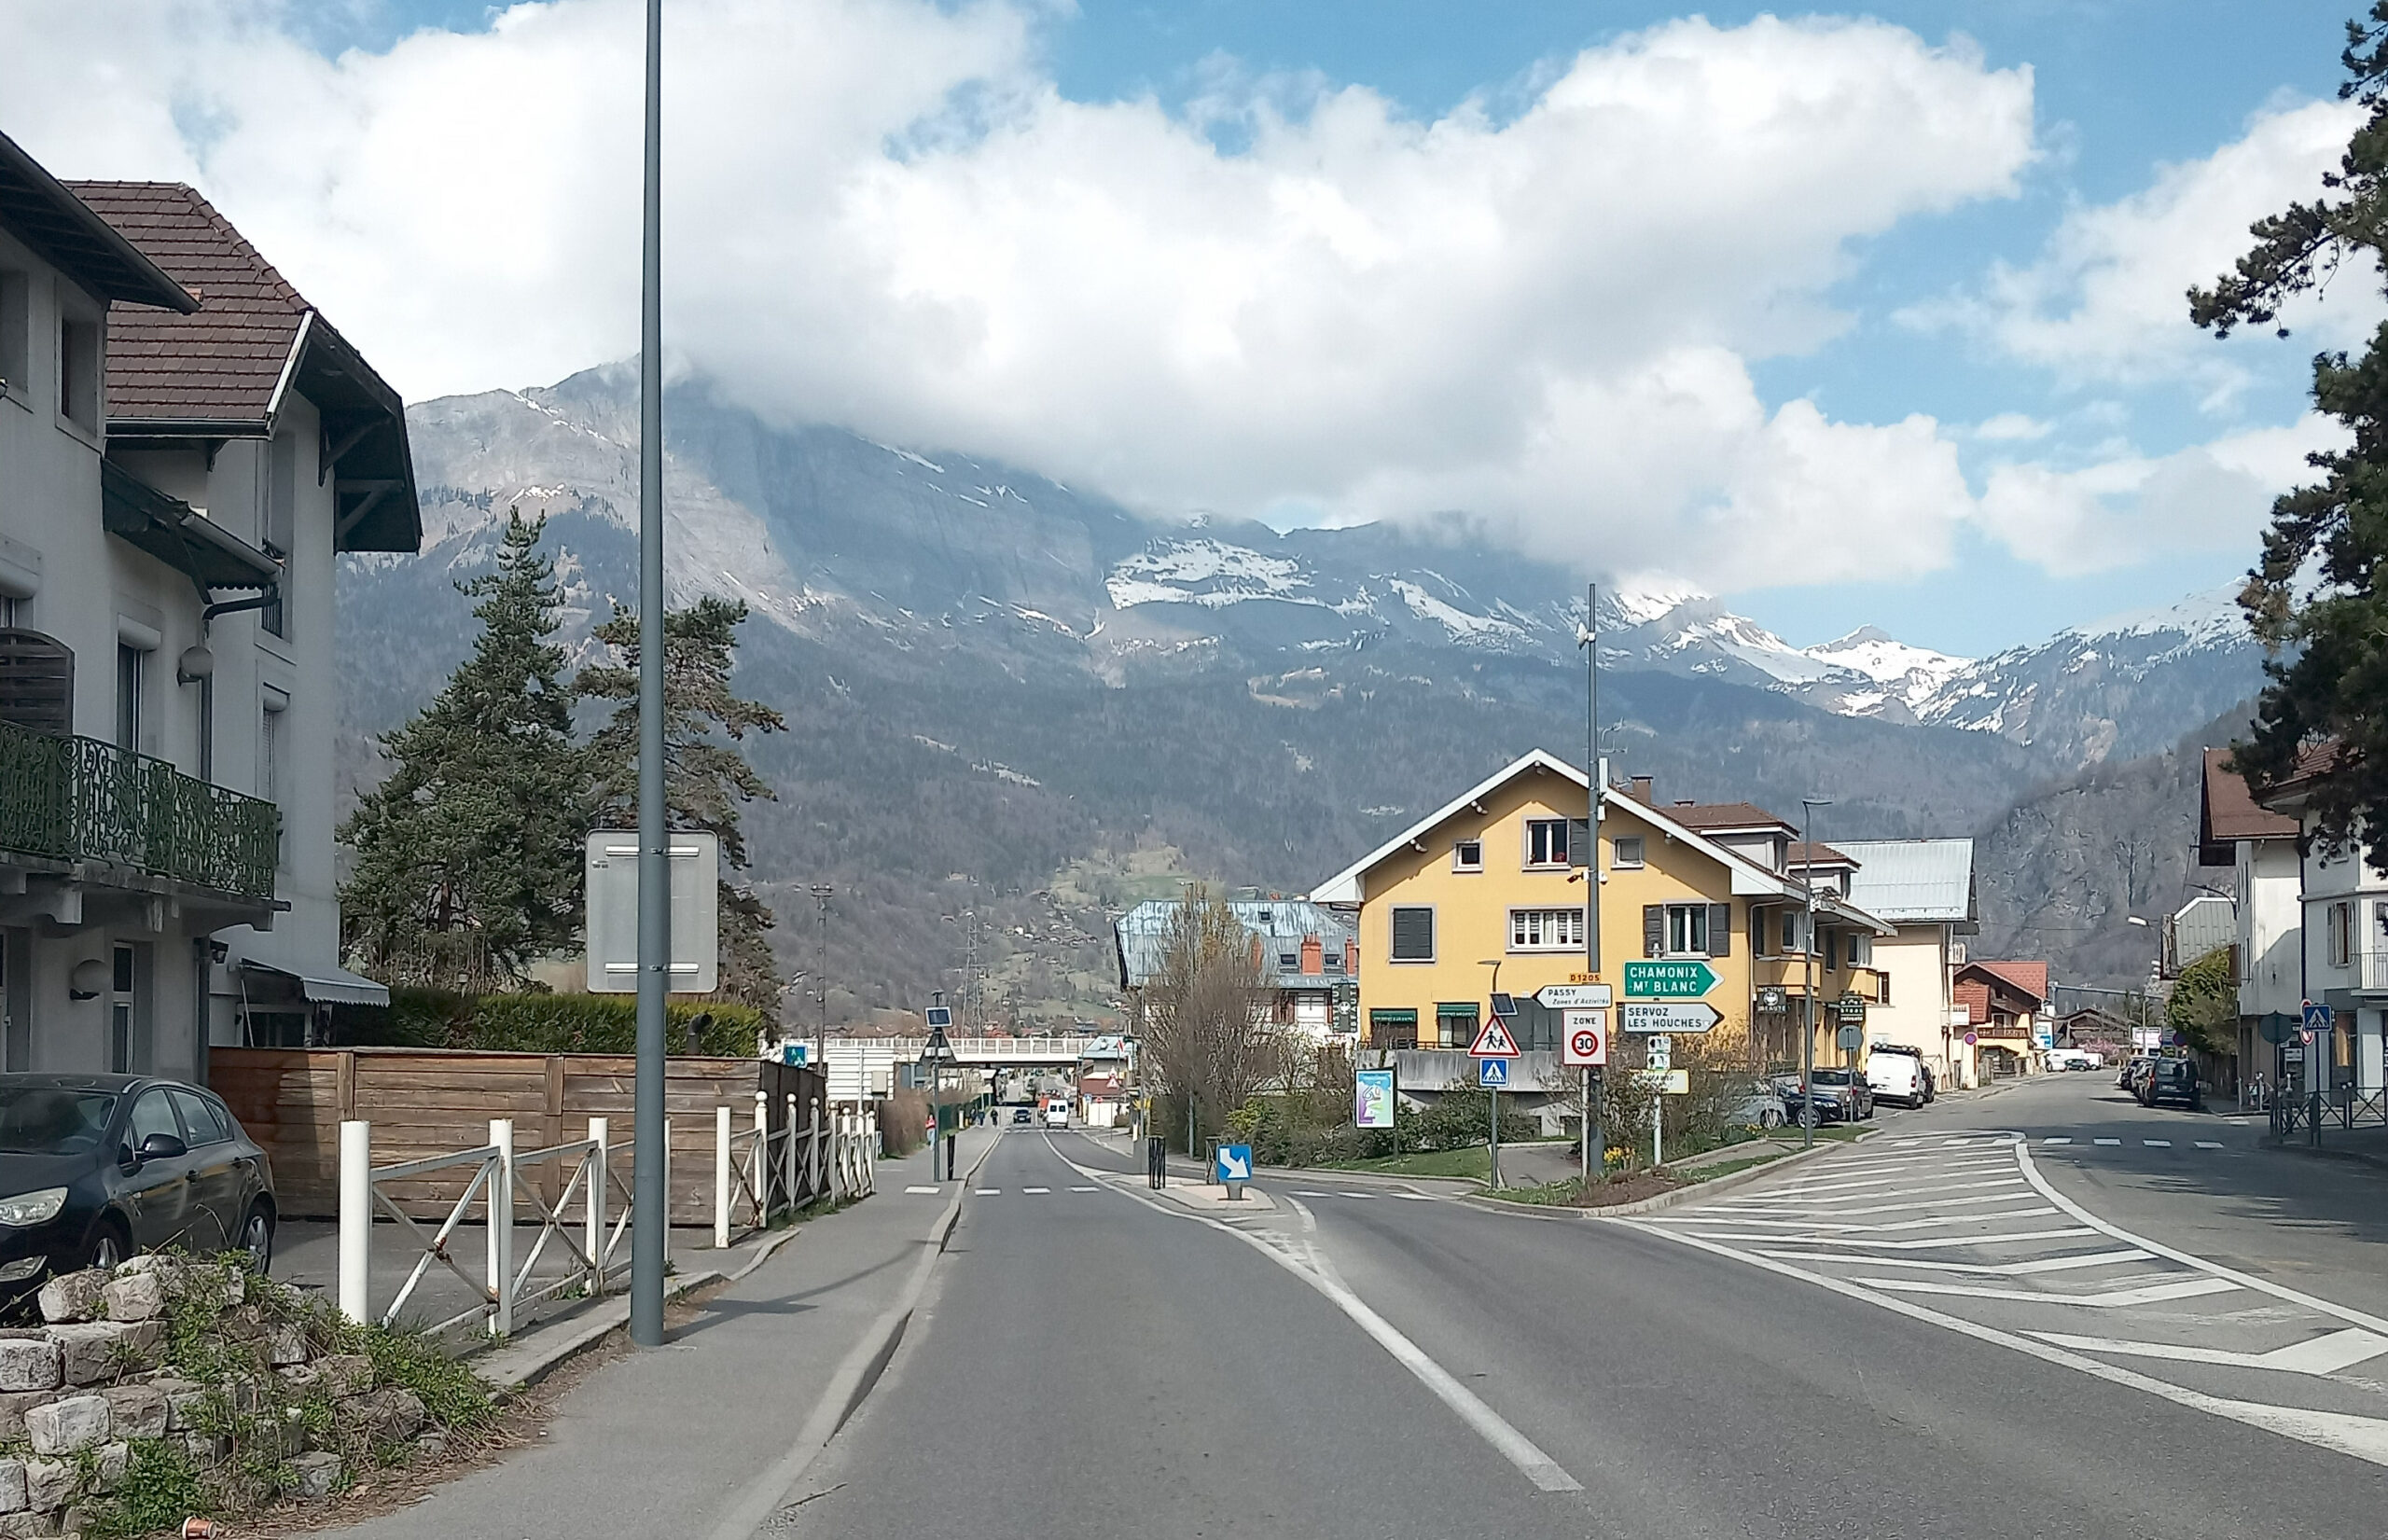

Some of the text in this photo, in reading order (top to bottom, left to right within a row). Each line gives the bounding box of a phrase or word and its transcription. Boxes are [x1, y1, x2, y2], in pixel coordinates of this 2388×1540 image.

[1630, 966, 1698, 978] CHAMONIX
[1653, 980, 1697, 992] BLANC
[1628, 1007, 1669, 1017] SERVOZ
[1628, 1019, 1701, 1028] LES HOUCHES
[1576, 1037, 1593, 1050] 30
